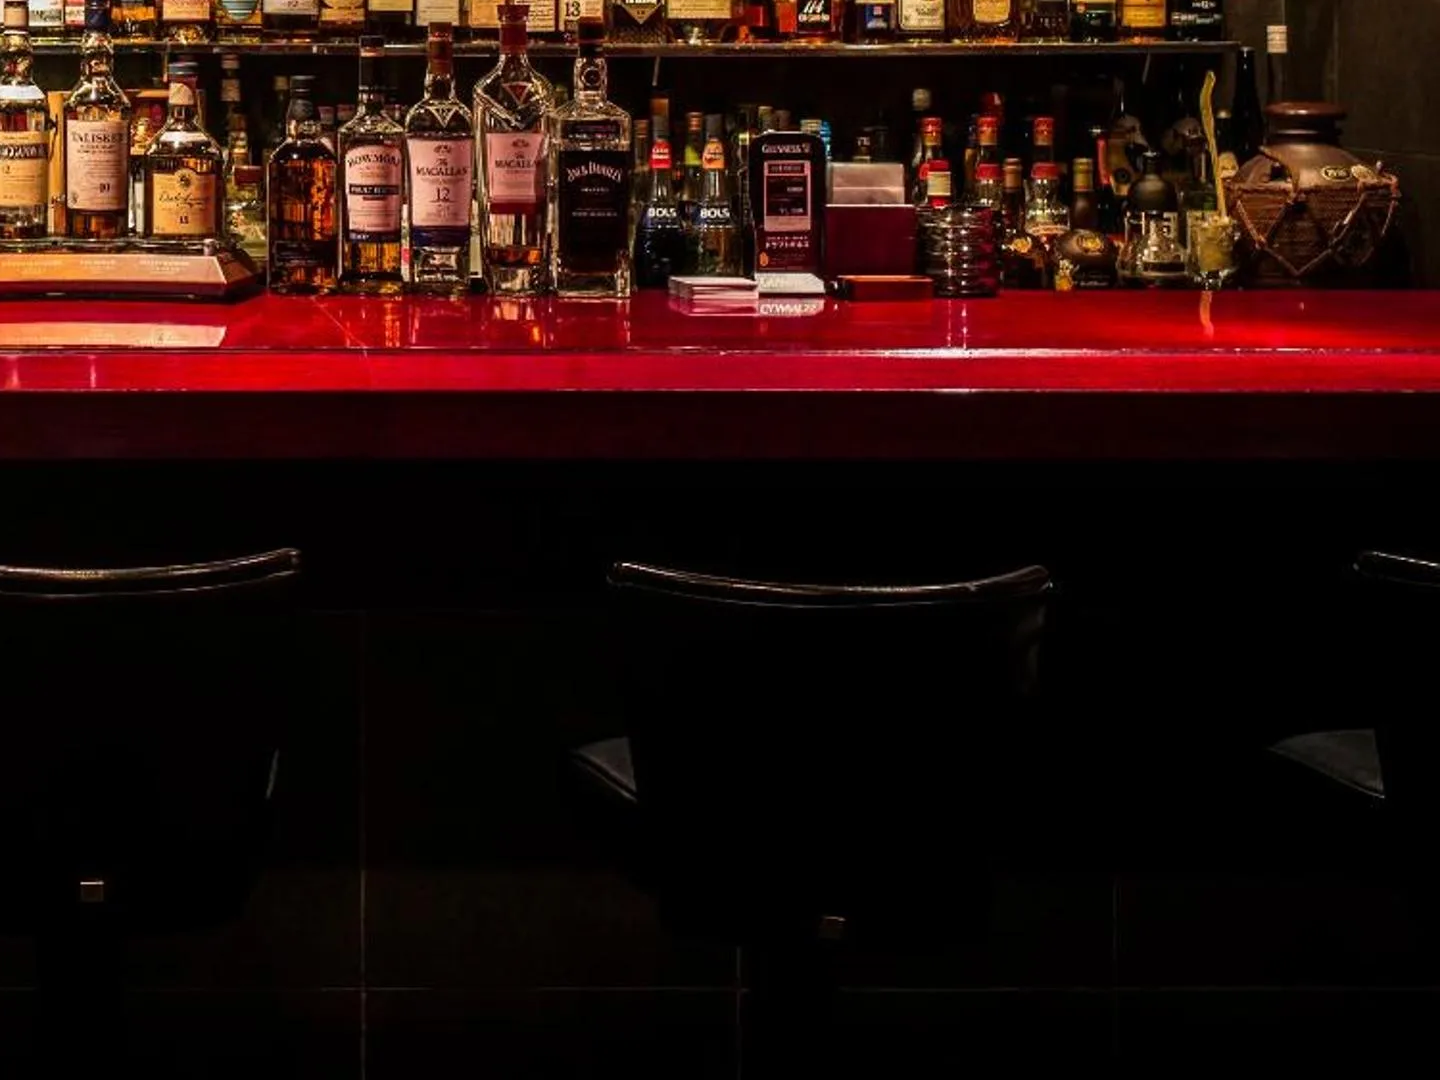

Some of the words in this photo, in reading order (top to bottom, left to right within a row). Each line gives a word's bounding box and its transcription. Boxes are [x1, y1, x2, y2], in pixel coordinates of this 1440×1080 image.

[565, 1, 581, 17] 13
[72, 131, 125, 143] TALISKER
[762, 144, 802, 154] GUINNESS
[416, 166, 468, 176] MACALLAN
[99, 183, 111, 193] 10
[435, 187, 450, 201] 12
[648, 207, 677, 218] BOLS
[700, 207, 730, 218] BOLS
